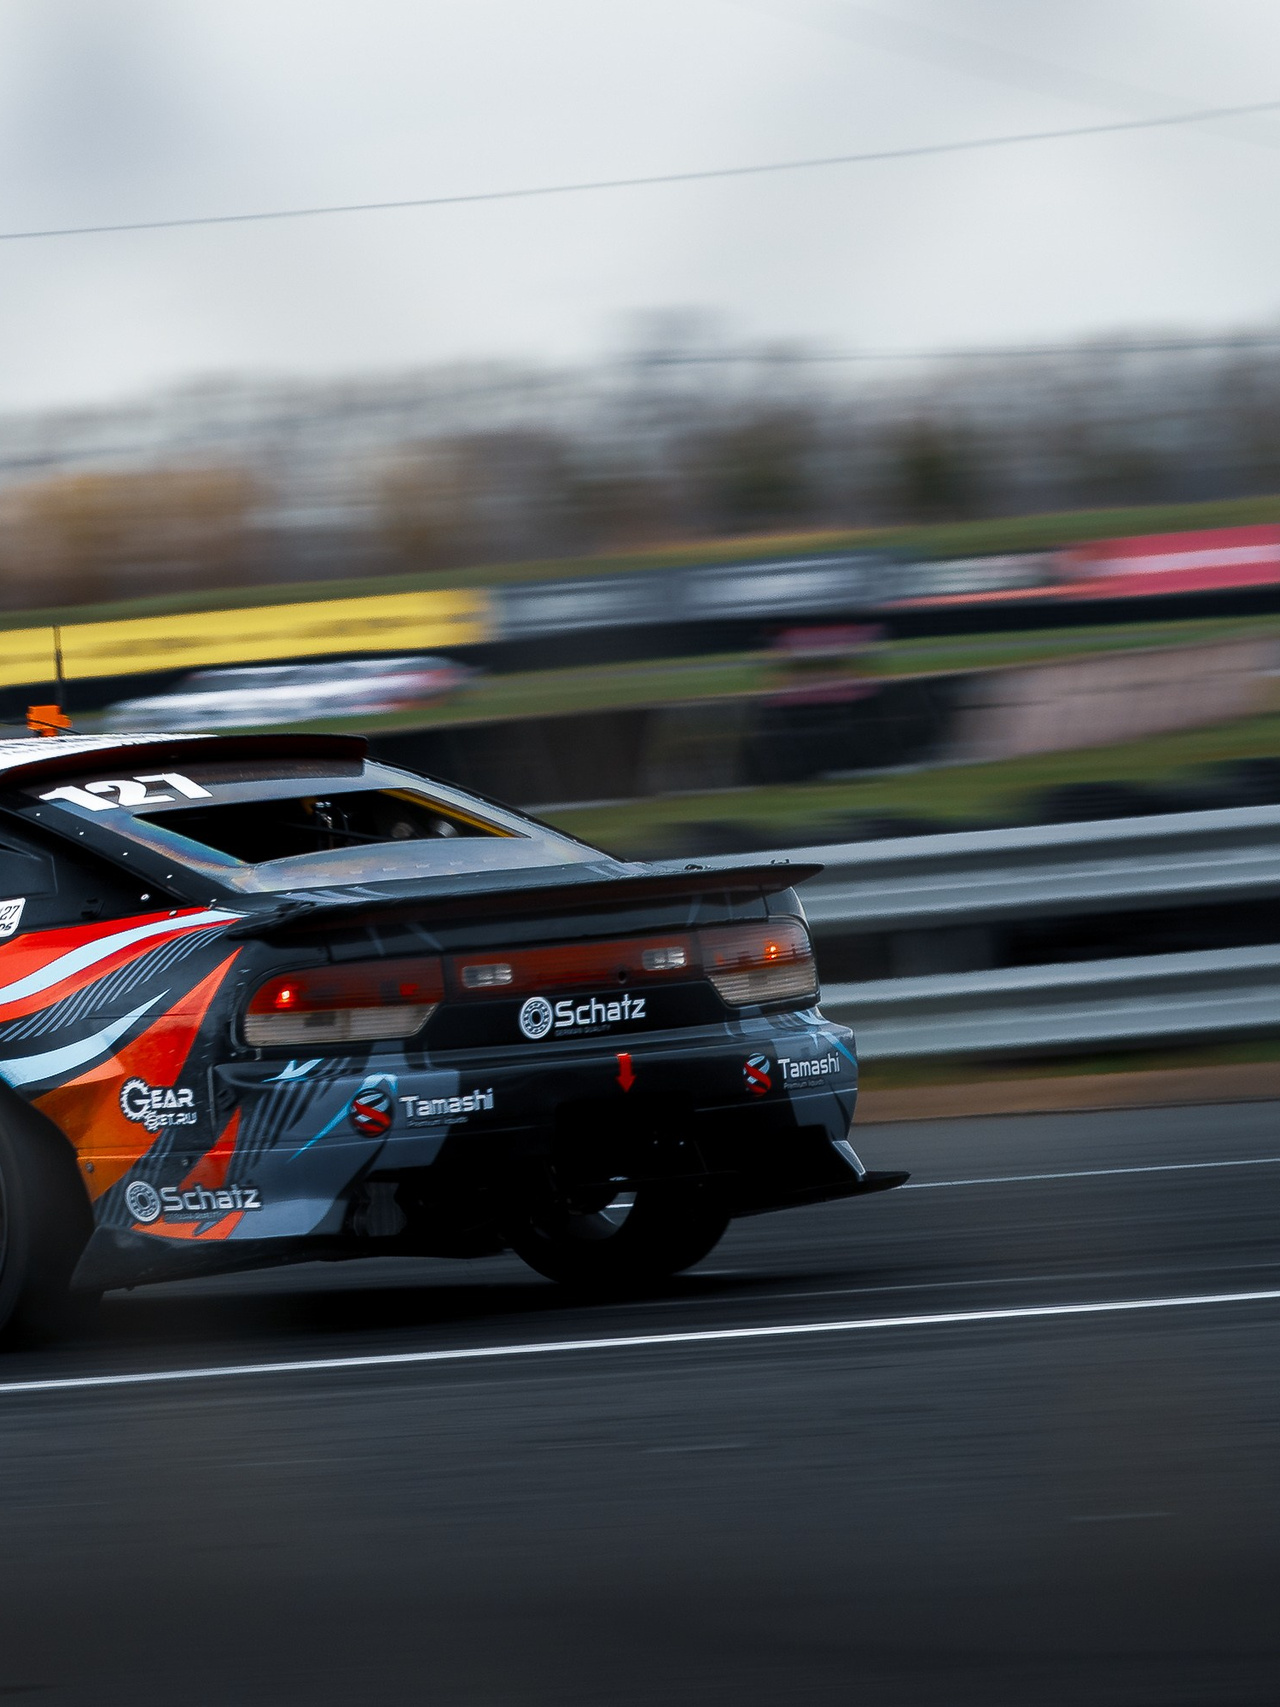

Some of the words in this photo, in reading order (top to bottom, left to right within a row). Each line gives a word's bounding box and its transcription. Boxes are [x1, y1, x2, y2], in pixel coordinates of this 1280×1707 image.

[39, 772, 213, 812] 127
[554, 994, 647, 1028] Schatz
[777, 1051, 840, 1080] Tamashi
[120, 1079, 196, 1121] GEAR
[399, 1087, 494, 1118] Tamashi
[160, 1183, 262, 1212] Schatz
